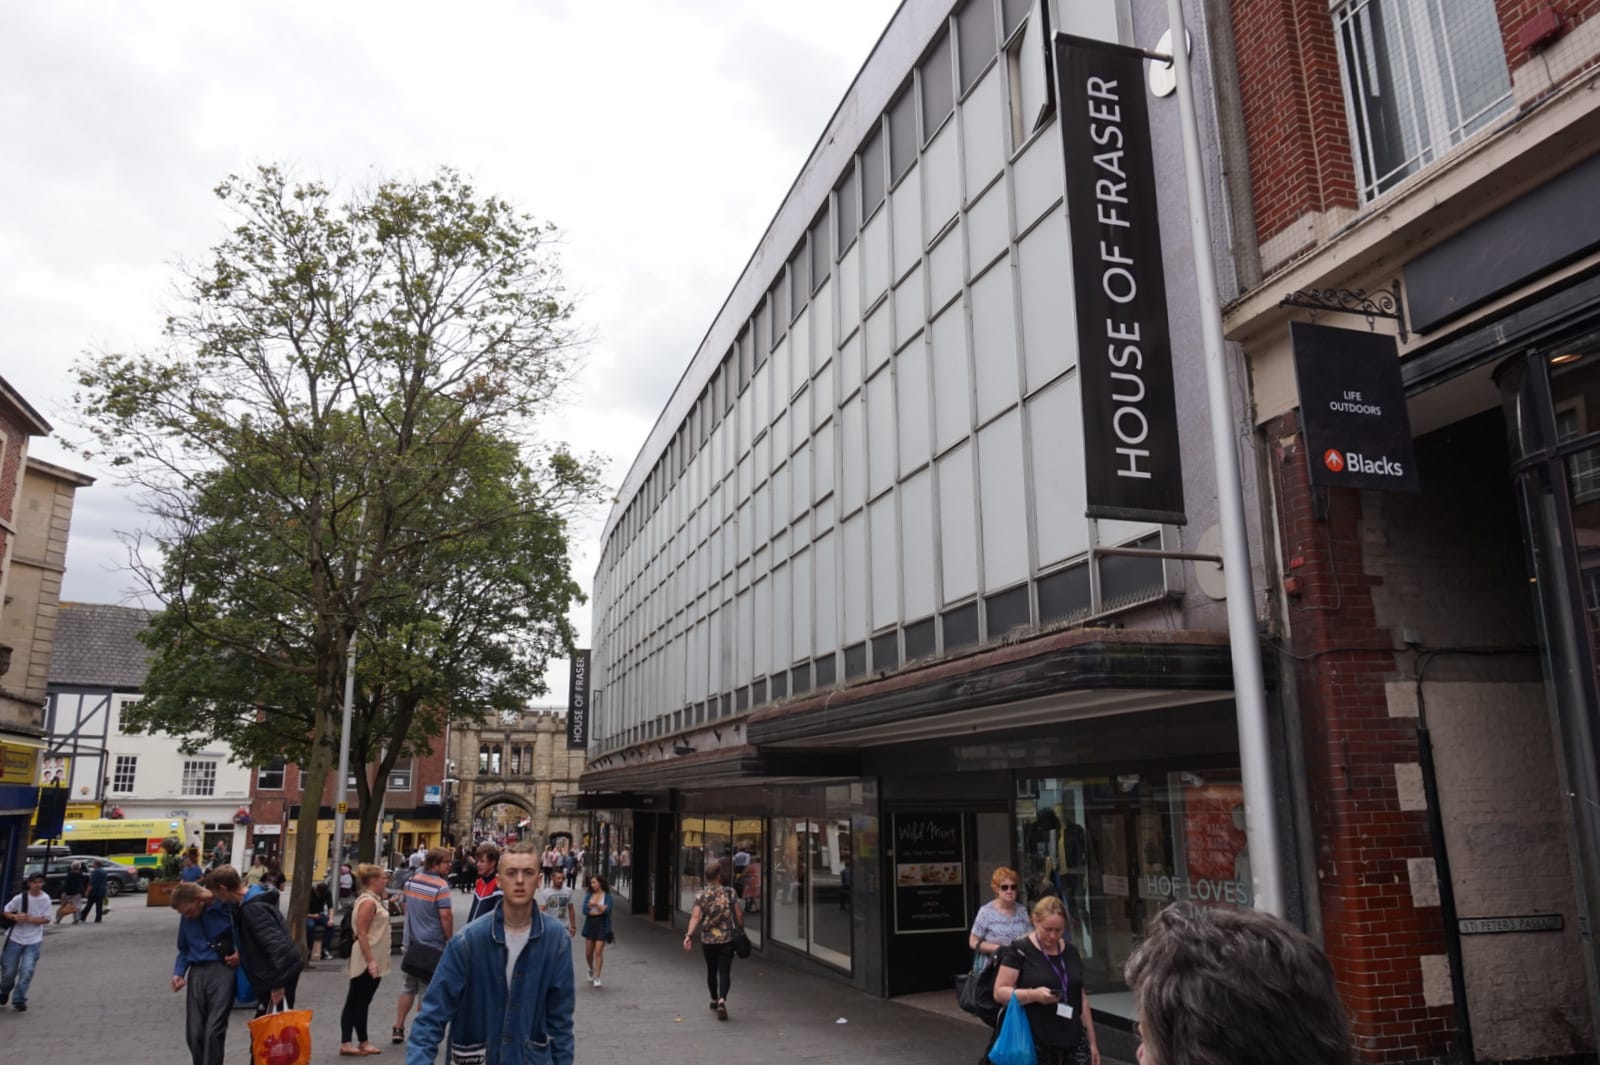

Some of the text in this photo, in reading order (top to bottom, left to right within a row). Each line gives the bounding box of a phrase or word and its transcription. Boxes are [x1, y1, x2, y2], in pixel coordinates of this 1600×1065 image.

[1086, 74, 1152, 480] HOUSE OF FRASER
[1329, 401, 1382, 415] OUTDOORS
[1343, 390, 1362, 401] LIFE
[1346, 452, 1403, 477] Blacks
[573, 656, 585, 743] HOUSE OF FRASER
[1147, 875, 1181, 897] HOF
[1189, 879, 1248, 904] LOVES
